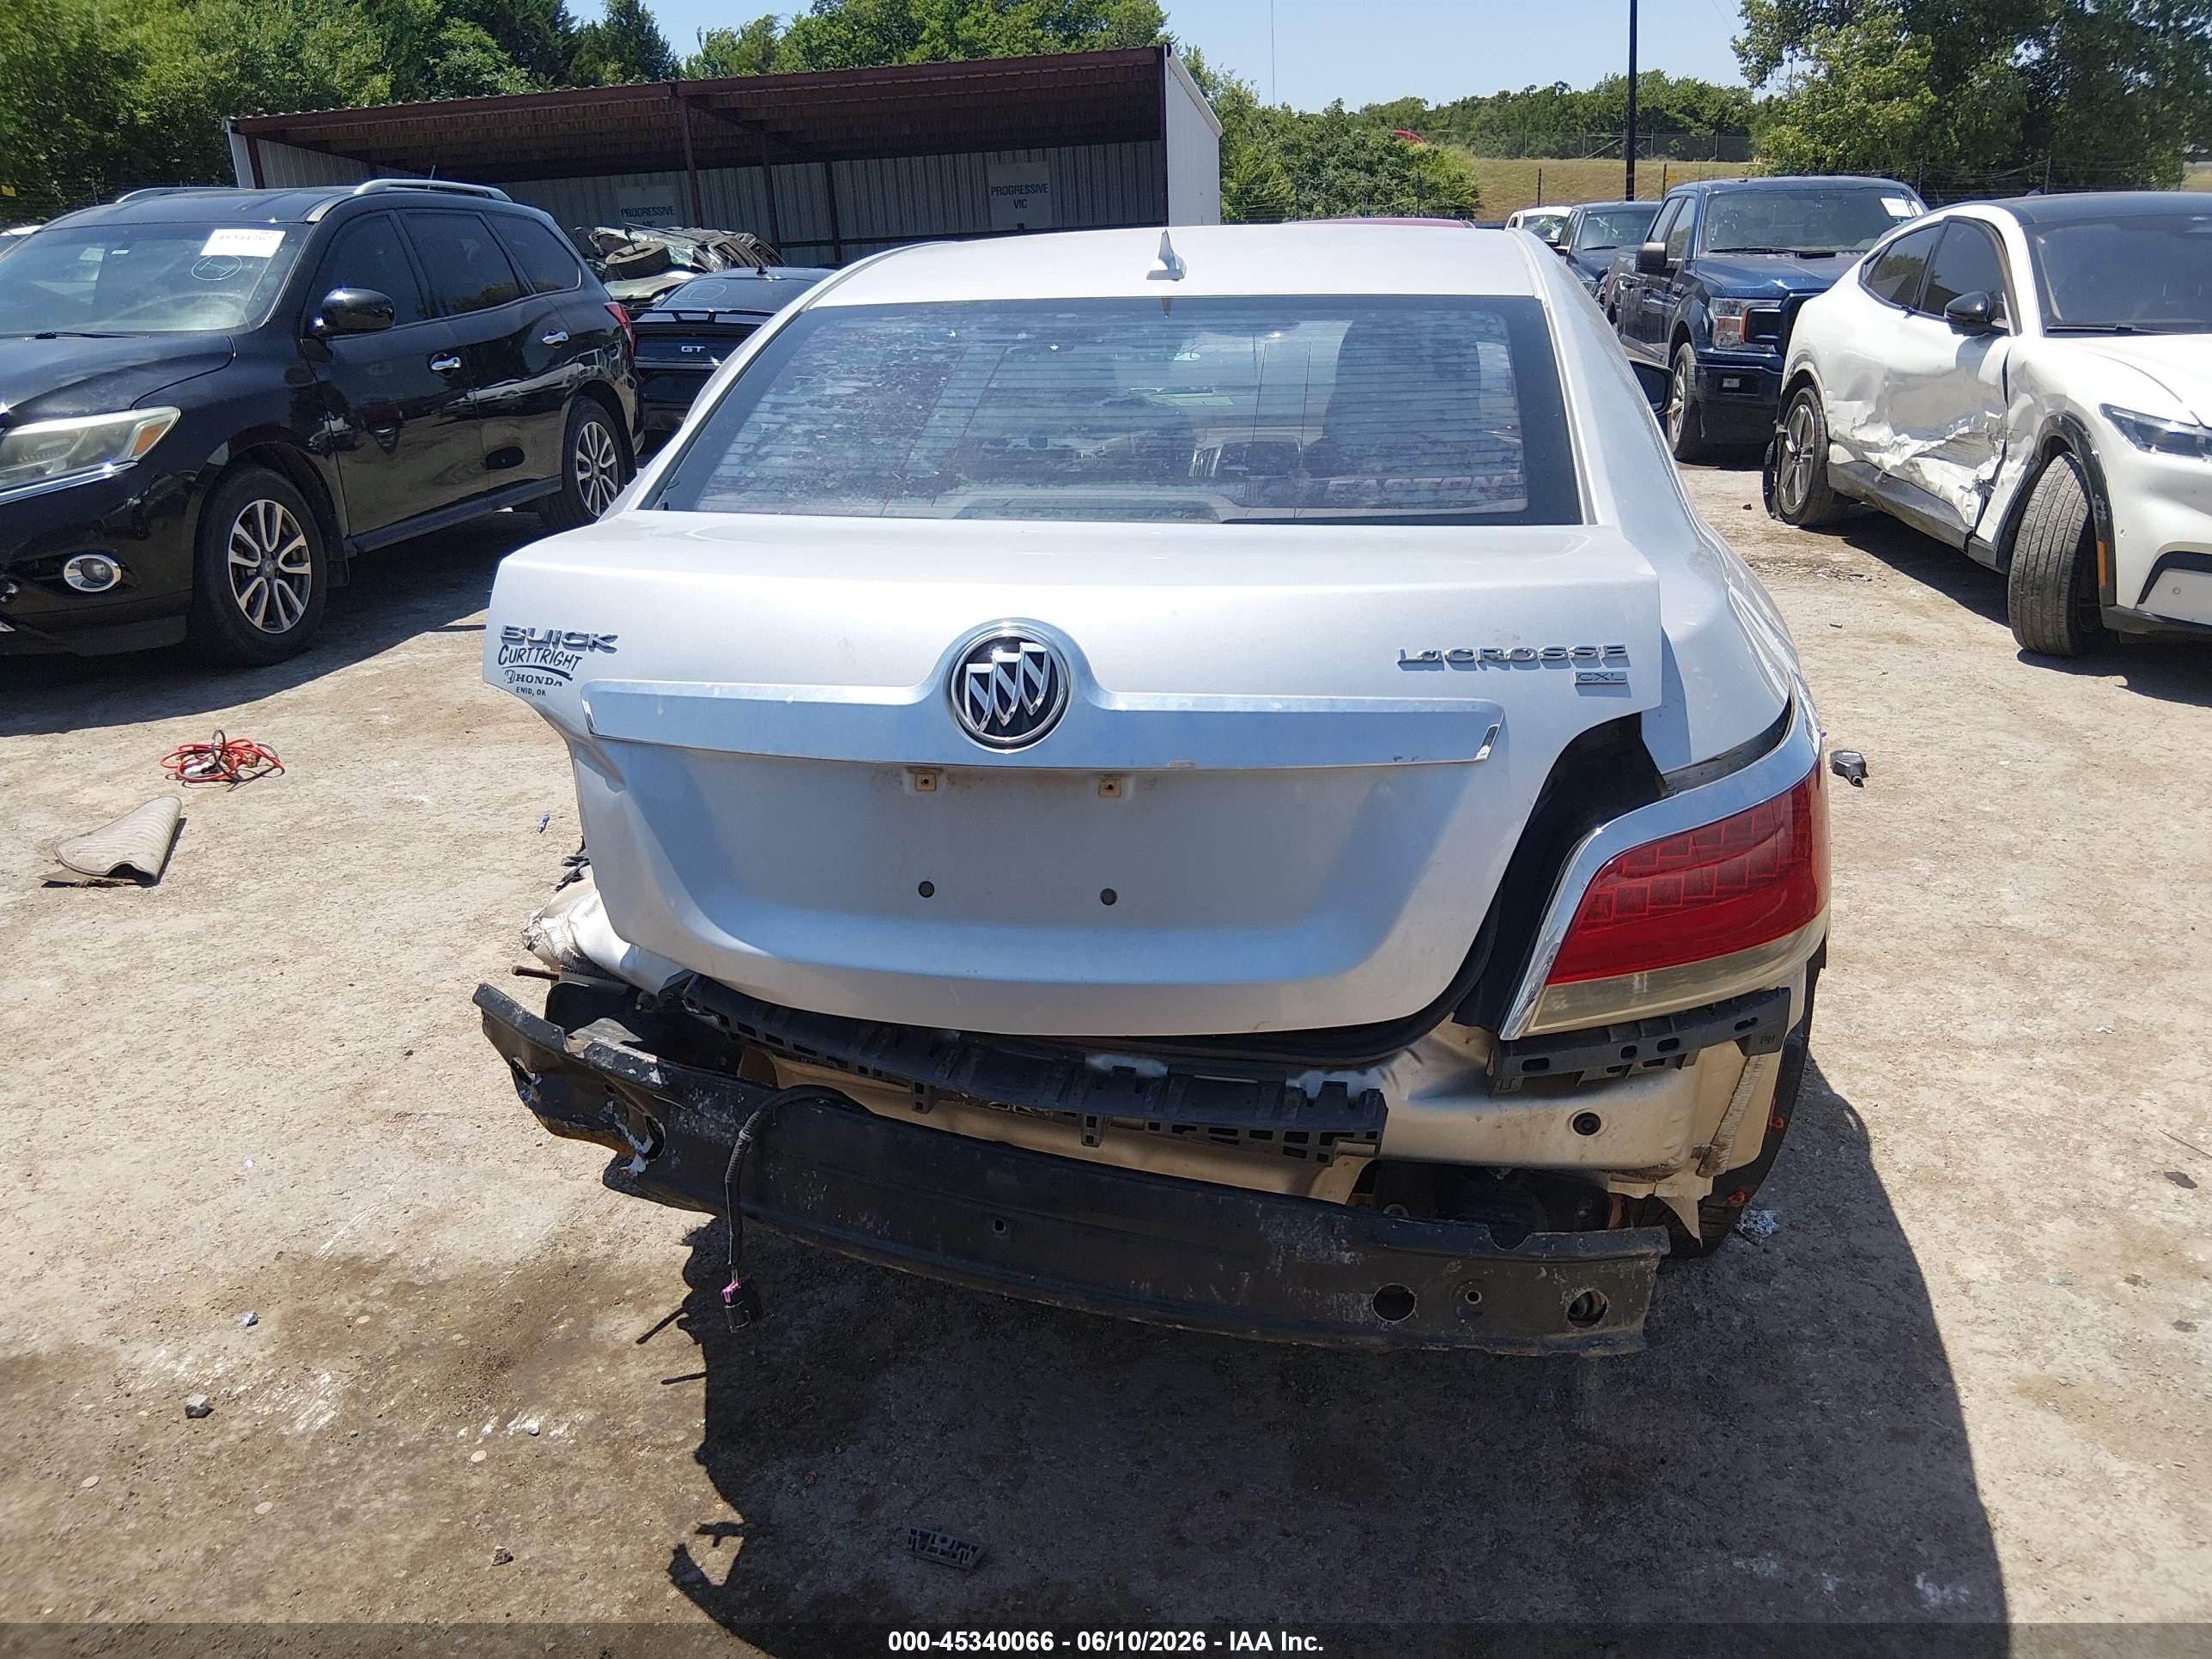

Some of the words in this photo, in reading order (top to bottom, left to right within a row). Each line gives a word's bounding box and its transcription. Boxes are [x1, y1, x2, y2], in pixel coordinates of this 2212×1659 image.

[991, 183, 1048, 196] PROGRESSIVE
[1013, 199, 1028, 209] VIC
[621, 206, 674, 217] PROGRESSIVE
[501, 625, 618, 653] BUICK
[498, 645, 583, 672] CURTTRIGHT
[516, 673, 563, 686] HONDA
[1577, 672, 1626, 682] CXL
[516, 687, 534, 696] ENID,
